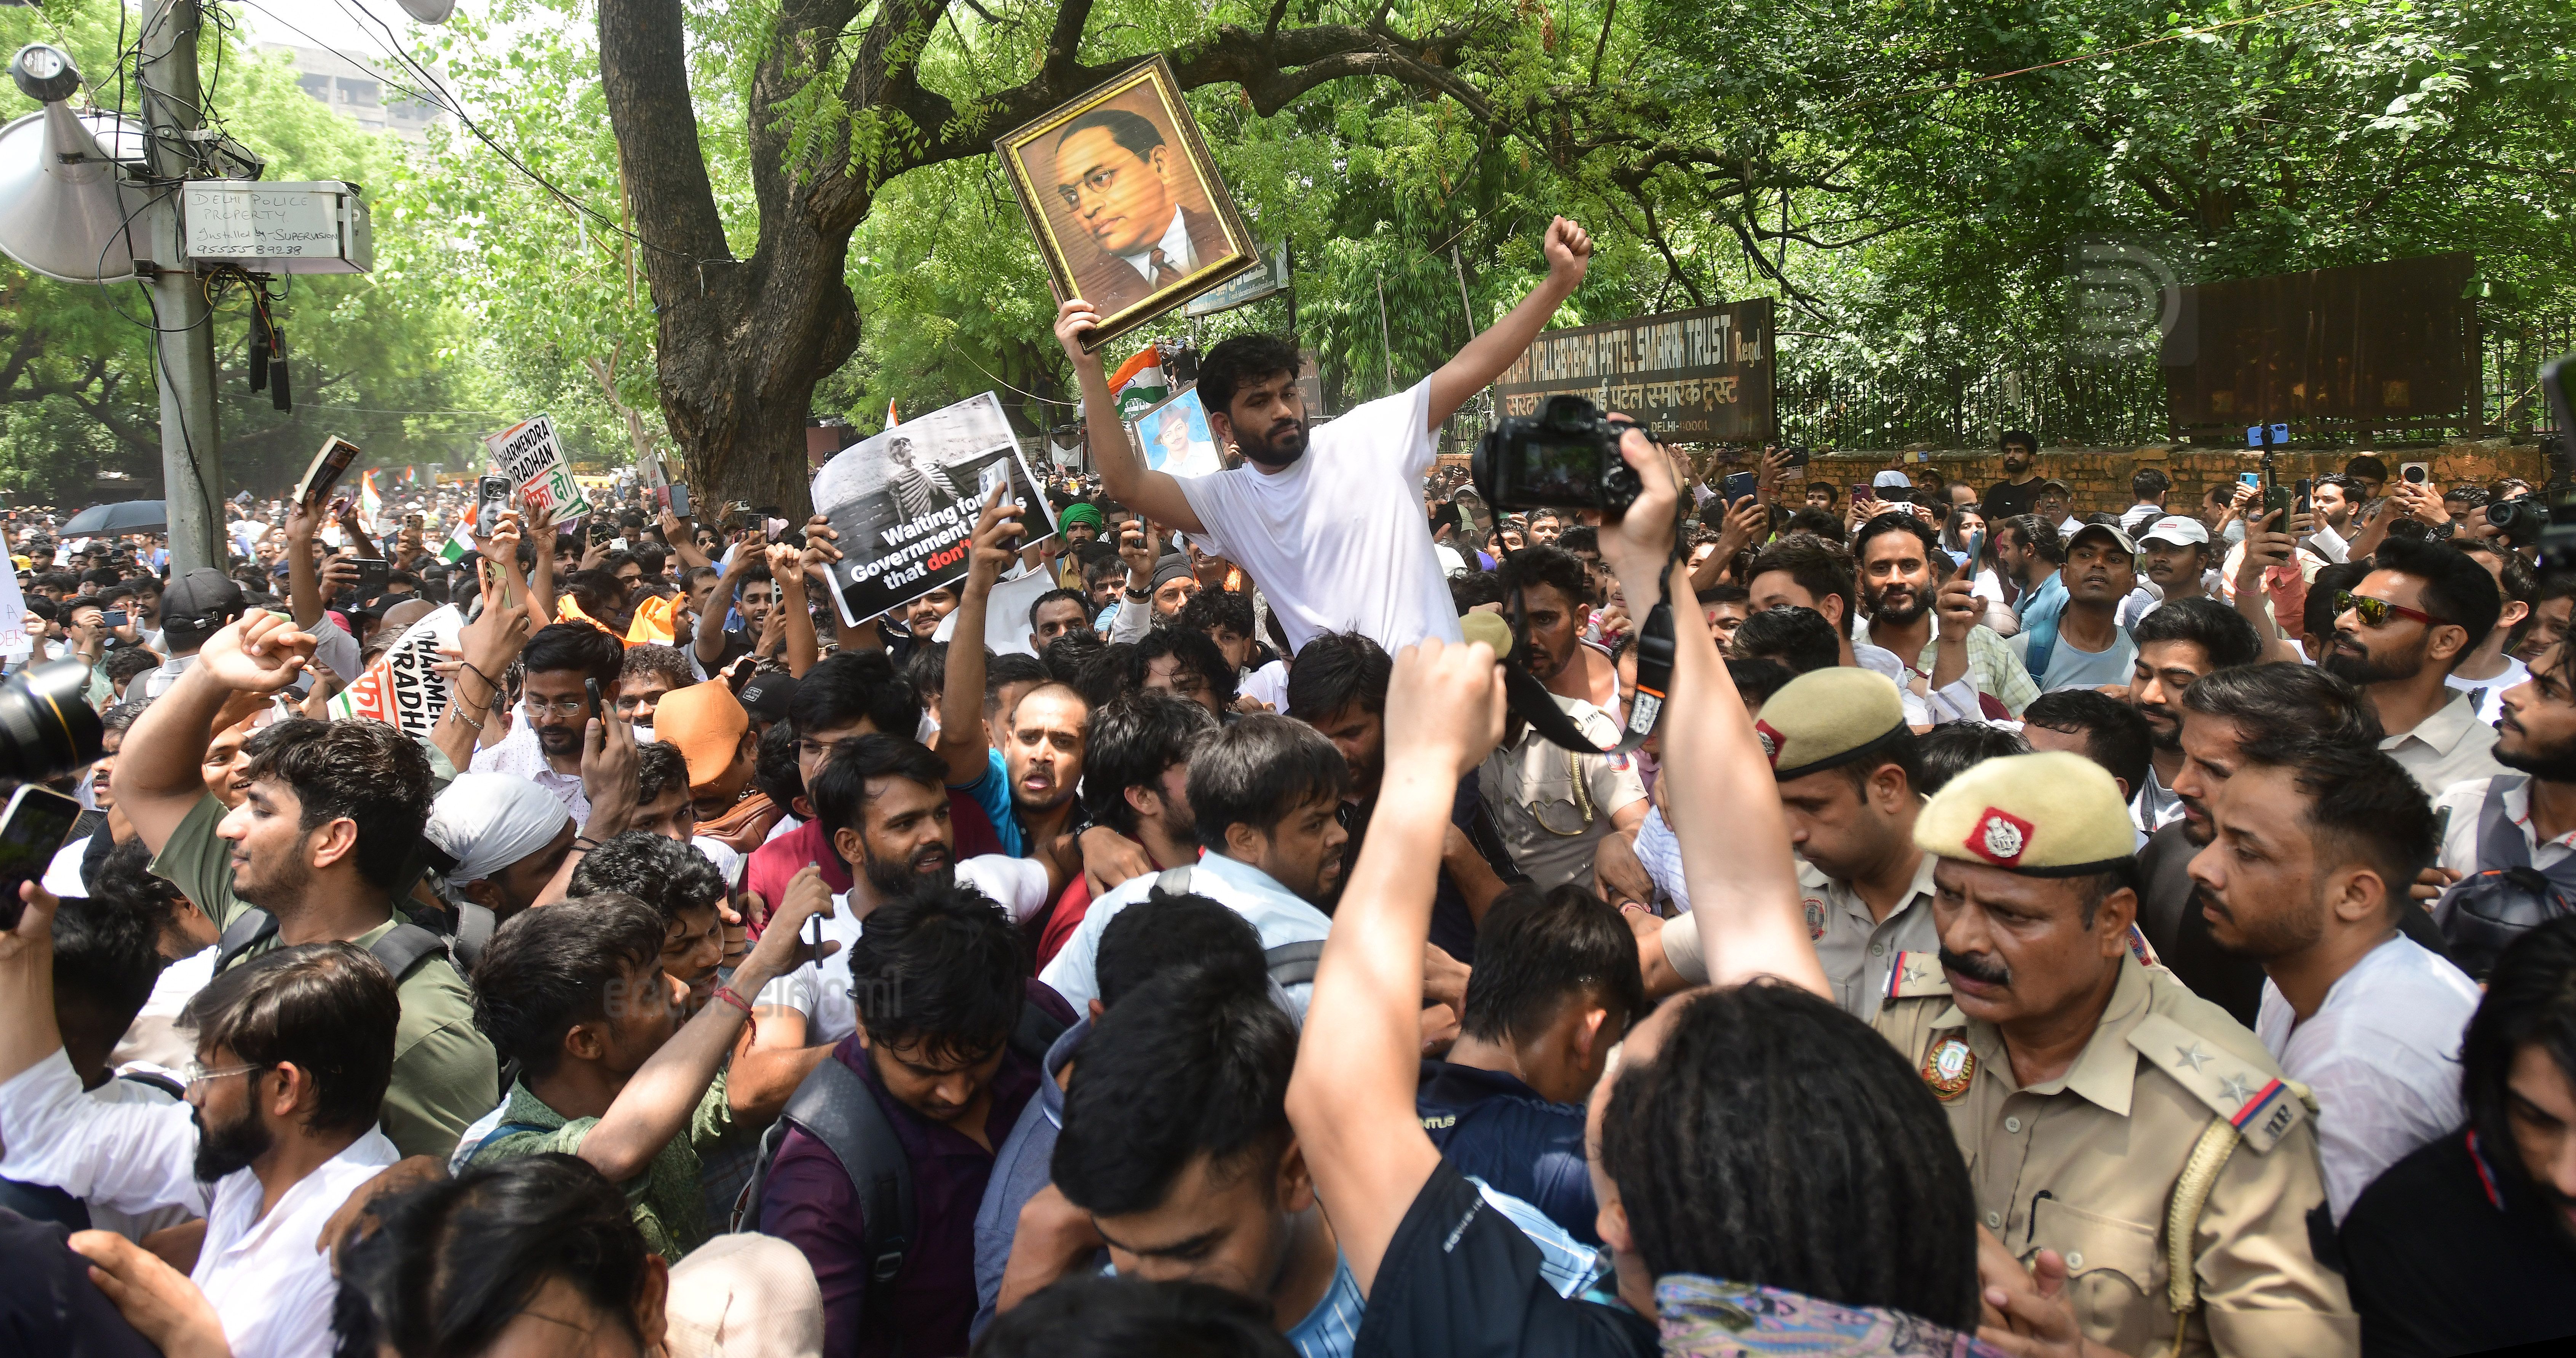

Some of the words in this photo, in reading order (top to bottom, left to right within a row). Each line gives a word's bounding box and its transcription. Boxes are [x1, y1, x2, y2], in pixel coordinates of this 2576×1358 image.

[192, 194, 241, 206] DELHI
[251, 194, 308, 206] POLICE
[1532, 334, 1597, 382] VALLABHBHAI
[1600, 329, 1635, 376] PATEL
[1637, 321, 1685, 372] SMARAK
[1687, 314, 1731, 366] TRUST
[1610, 377, 1644, 410] पटेल
[1647, 378, 1700, 408] स्मारक
[499, 420, 550, 469] DHARMENDRA
[508, 442, 555, 488] PRADHAN
[881, 505, 959, 547] Waiting
[956, 494, 983, 515] for
[850, 520, 970, 583] Government
[883, 560, 928, 590] that
[6, 604, 18, 620] A
